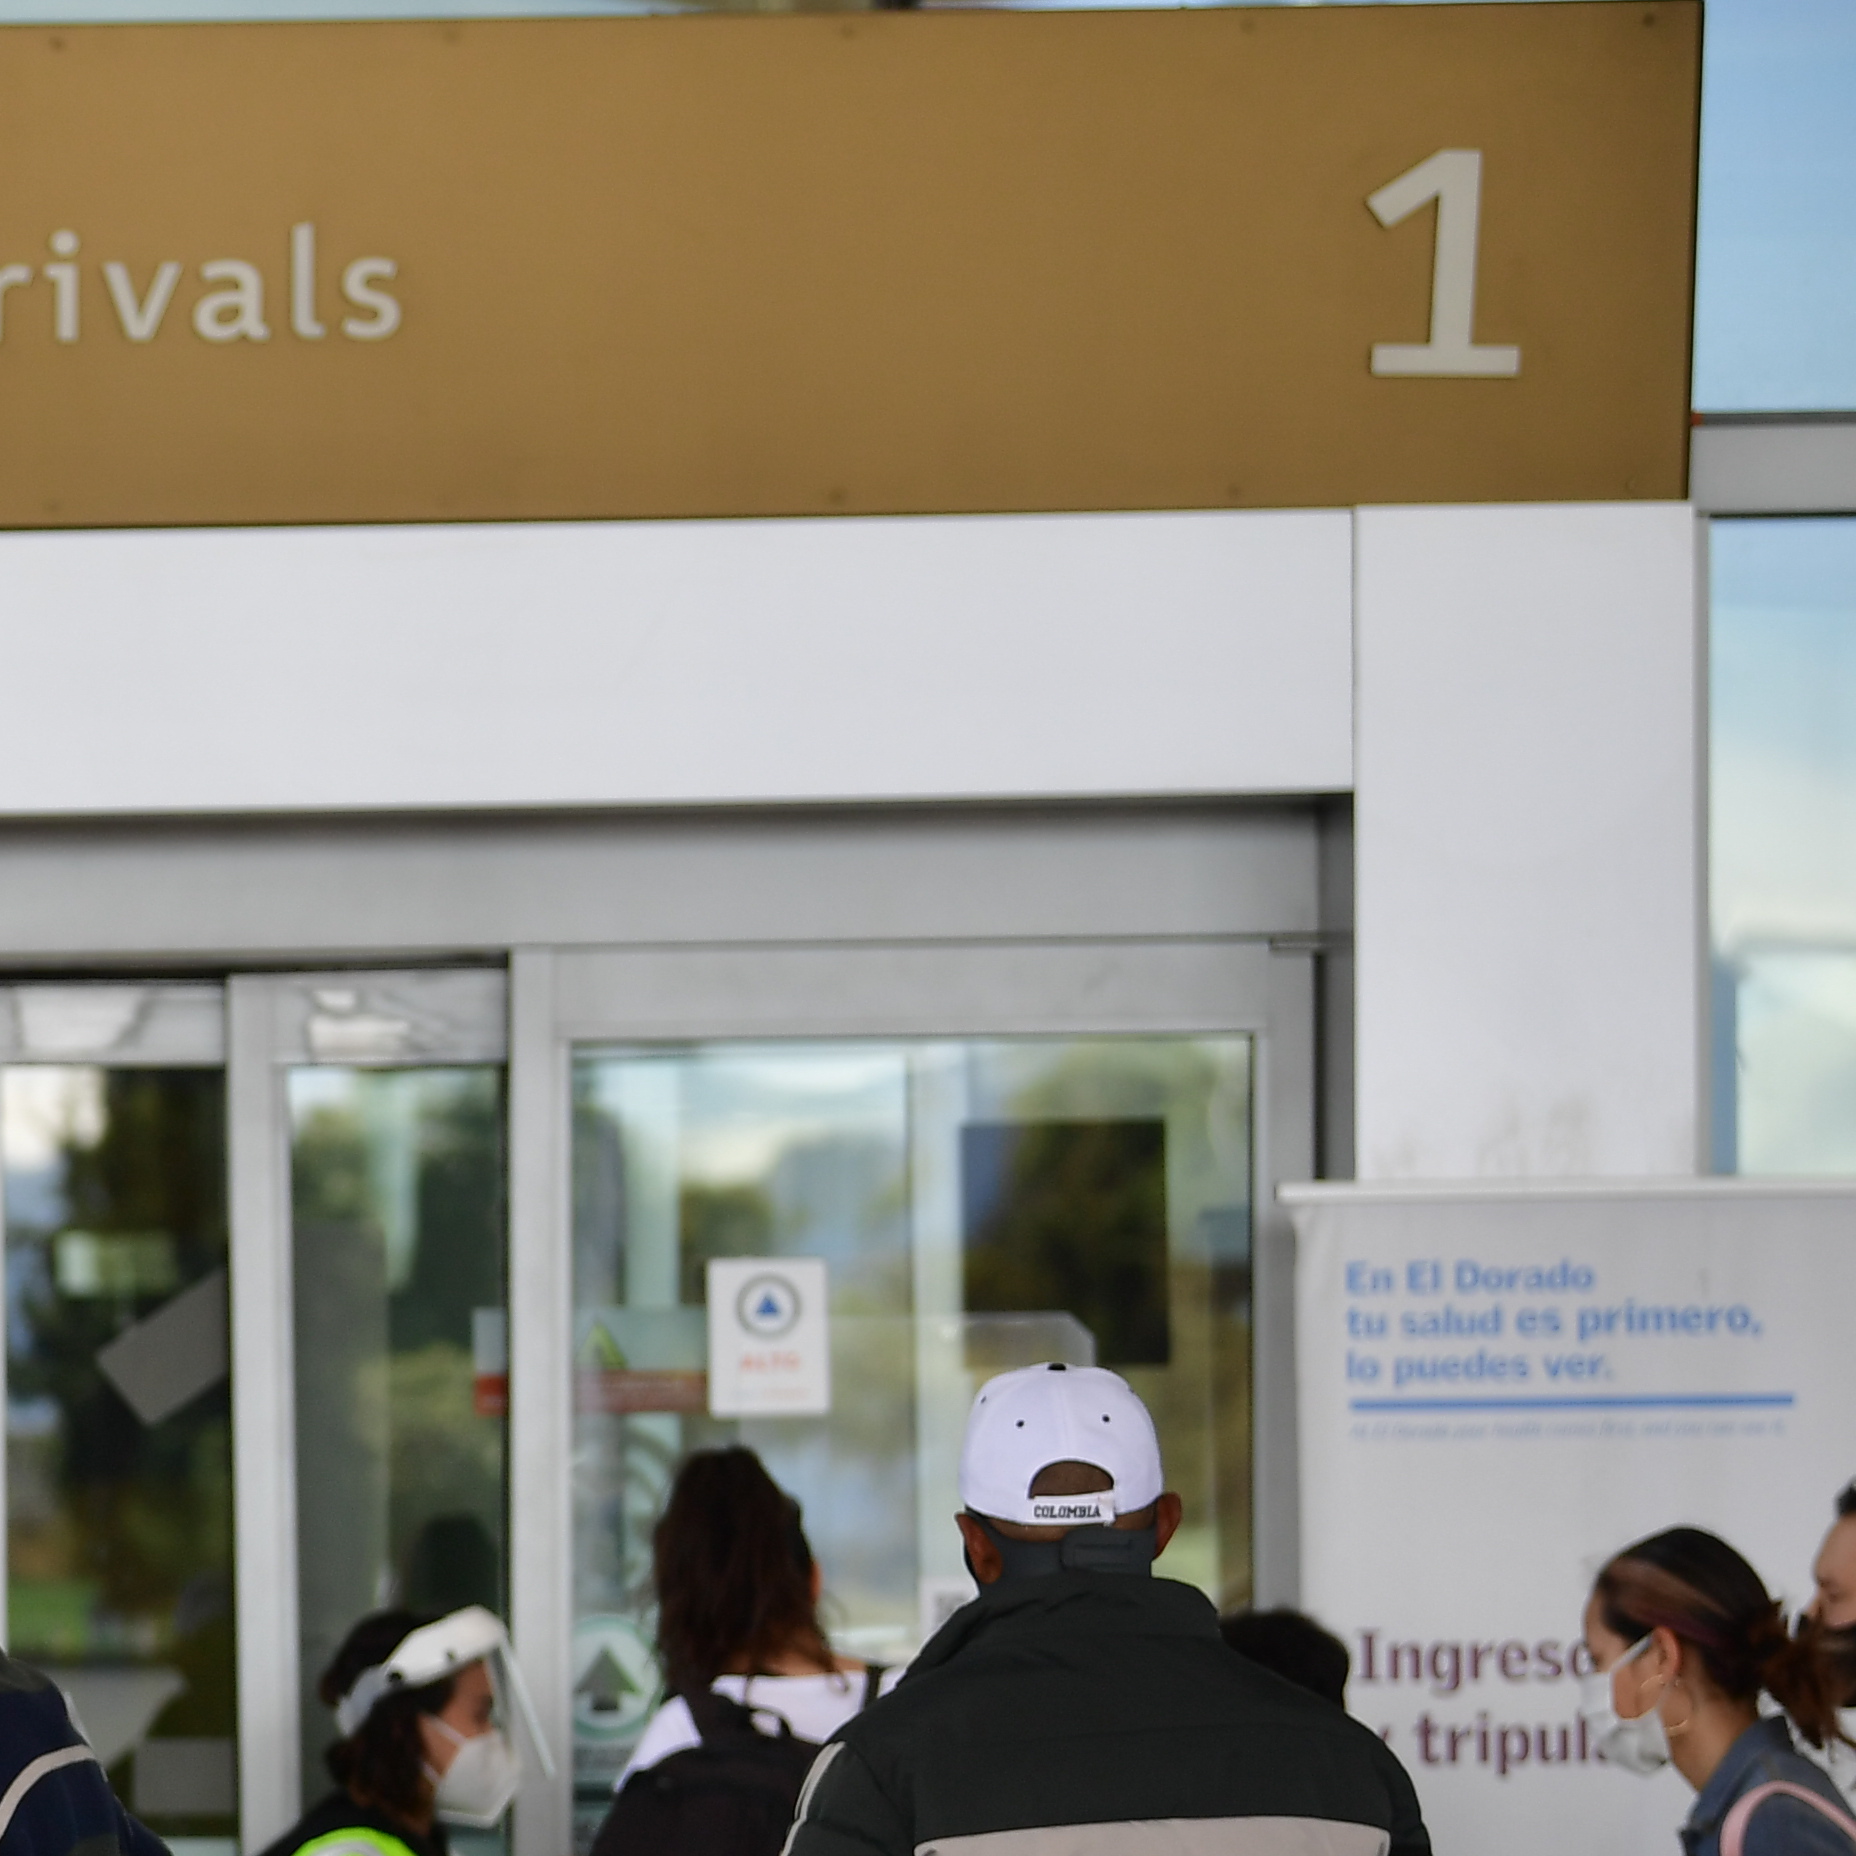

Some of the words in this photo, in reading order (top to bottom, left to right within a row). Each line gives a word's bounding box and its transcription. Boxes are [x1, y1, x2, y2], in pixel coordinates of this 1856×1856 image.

[1365, 148, 1521, 377] 1
[1347, 1261, 1392, 1291] En
[1408, 1260, 1441, 1292] El
[1456, 1257, 1595, 1292] Dorado
[1347, 1307, 1387, 1337] tu
[1401, 1304, 1502, 1336] salud
[1516, 1307, 1561, 1333] es
[1578, 1299, 1762, 1340] primero,
[1347, 1350, 1379, 1380] lo
[1395, 1348, 1530, 1388] puedes
[1033, 1503, 1102, 1519] COLOMBIA
[1415, 1710, 1608, 1779] tripul
